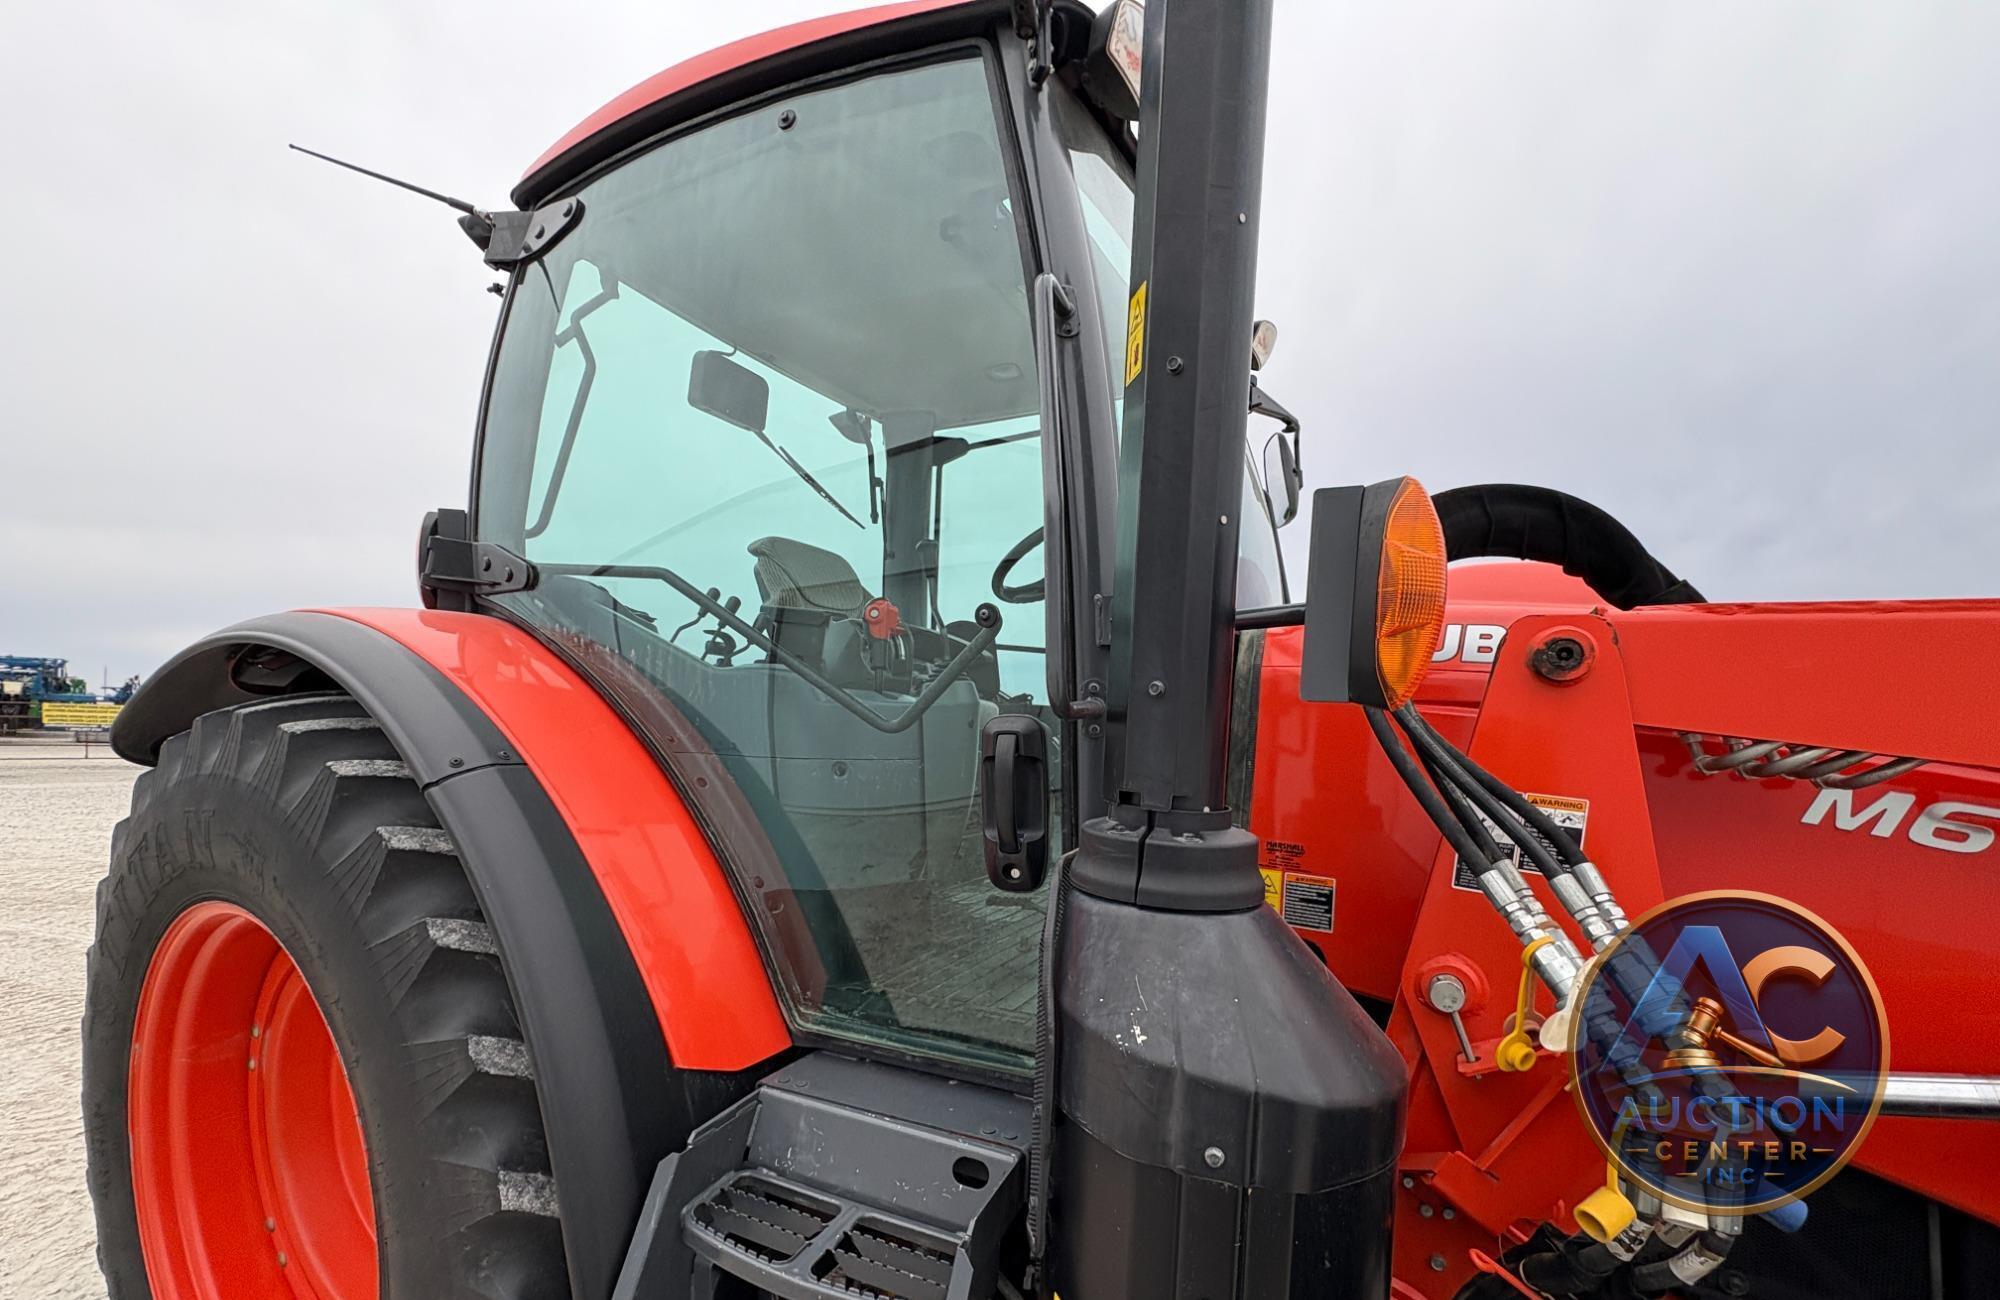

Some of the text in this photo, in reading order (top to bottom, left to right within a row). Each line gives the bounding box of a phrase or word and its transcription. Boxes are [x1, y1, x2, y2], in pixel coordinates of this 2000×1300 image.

[1540, 798, 1583, 810] WARNING
[1800, 788, 2000, 853] M6
[101, 808, 216, 979] TITAN
